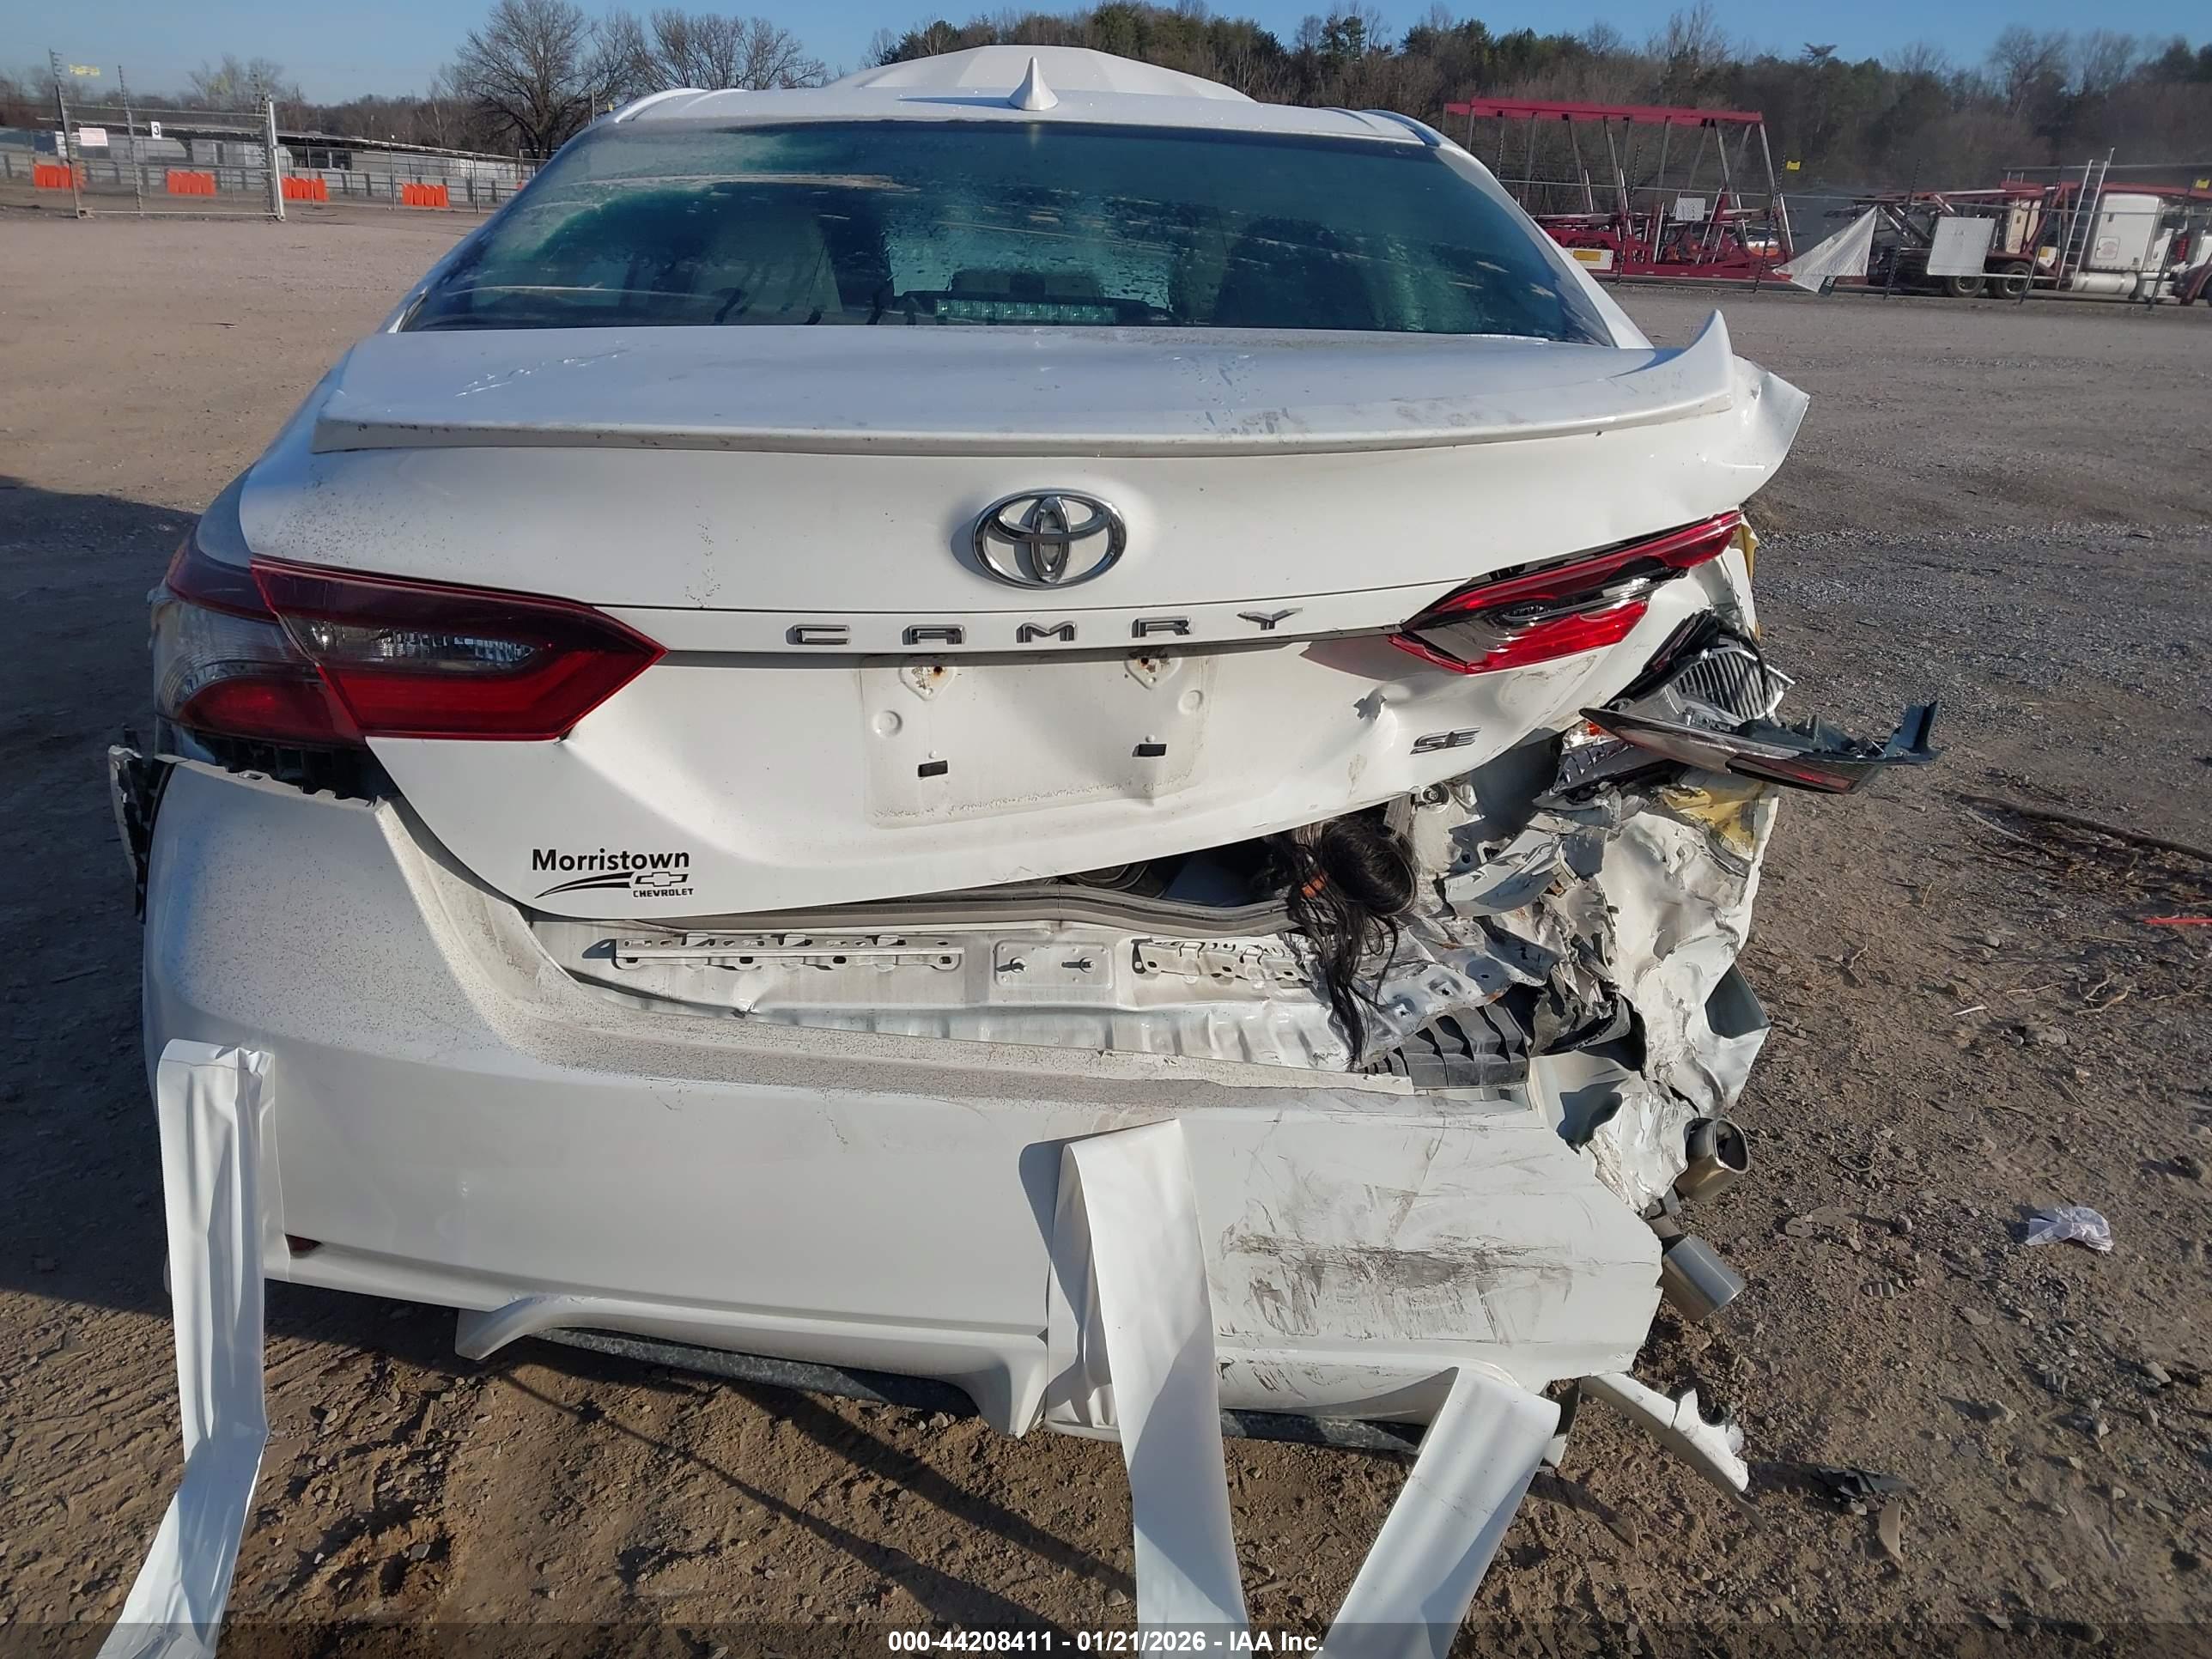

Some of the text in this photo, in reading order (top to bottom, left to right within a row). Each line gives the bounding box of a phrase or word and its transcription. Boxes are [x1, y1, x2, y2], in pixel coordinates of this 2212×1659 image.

[154, 125, 160, 135] 3
[787, 607, 1304, 645] CAMRY
[1409, 726, 1482, 755] SE
[532, 848, 690, 872] Morristown
[633, 888, 694, 898] CHEVROLET
